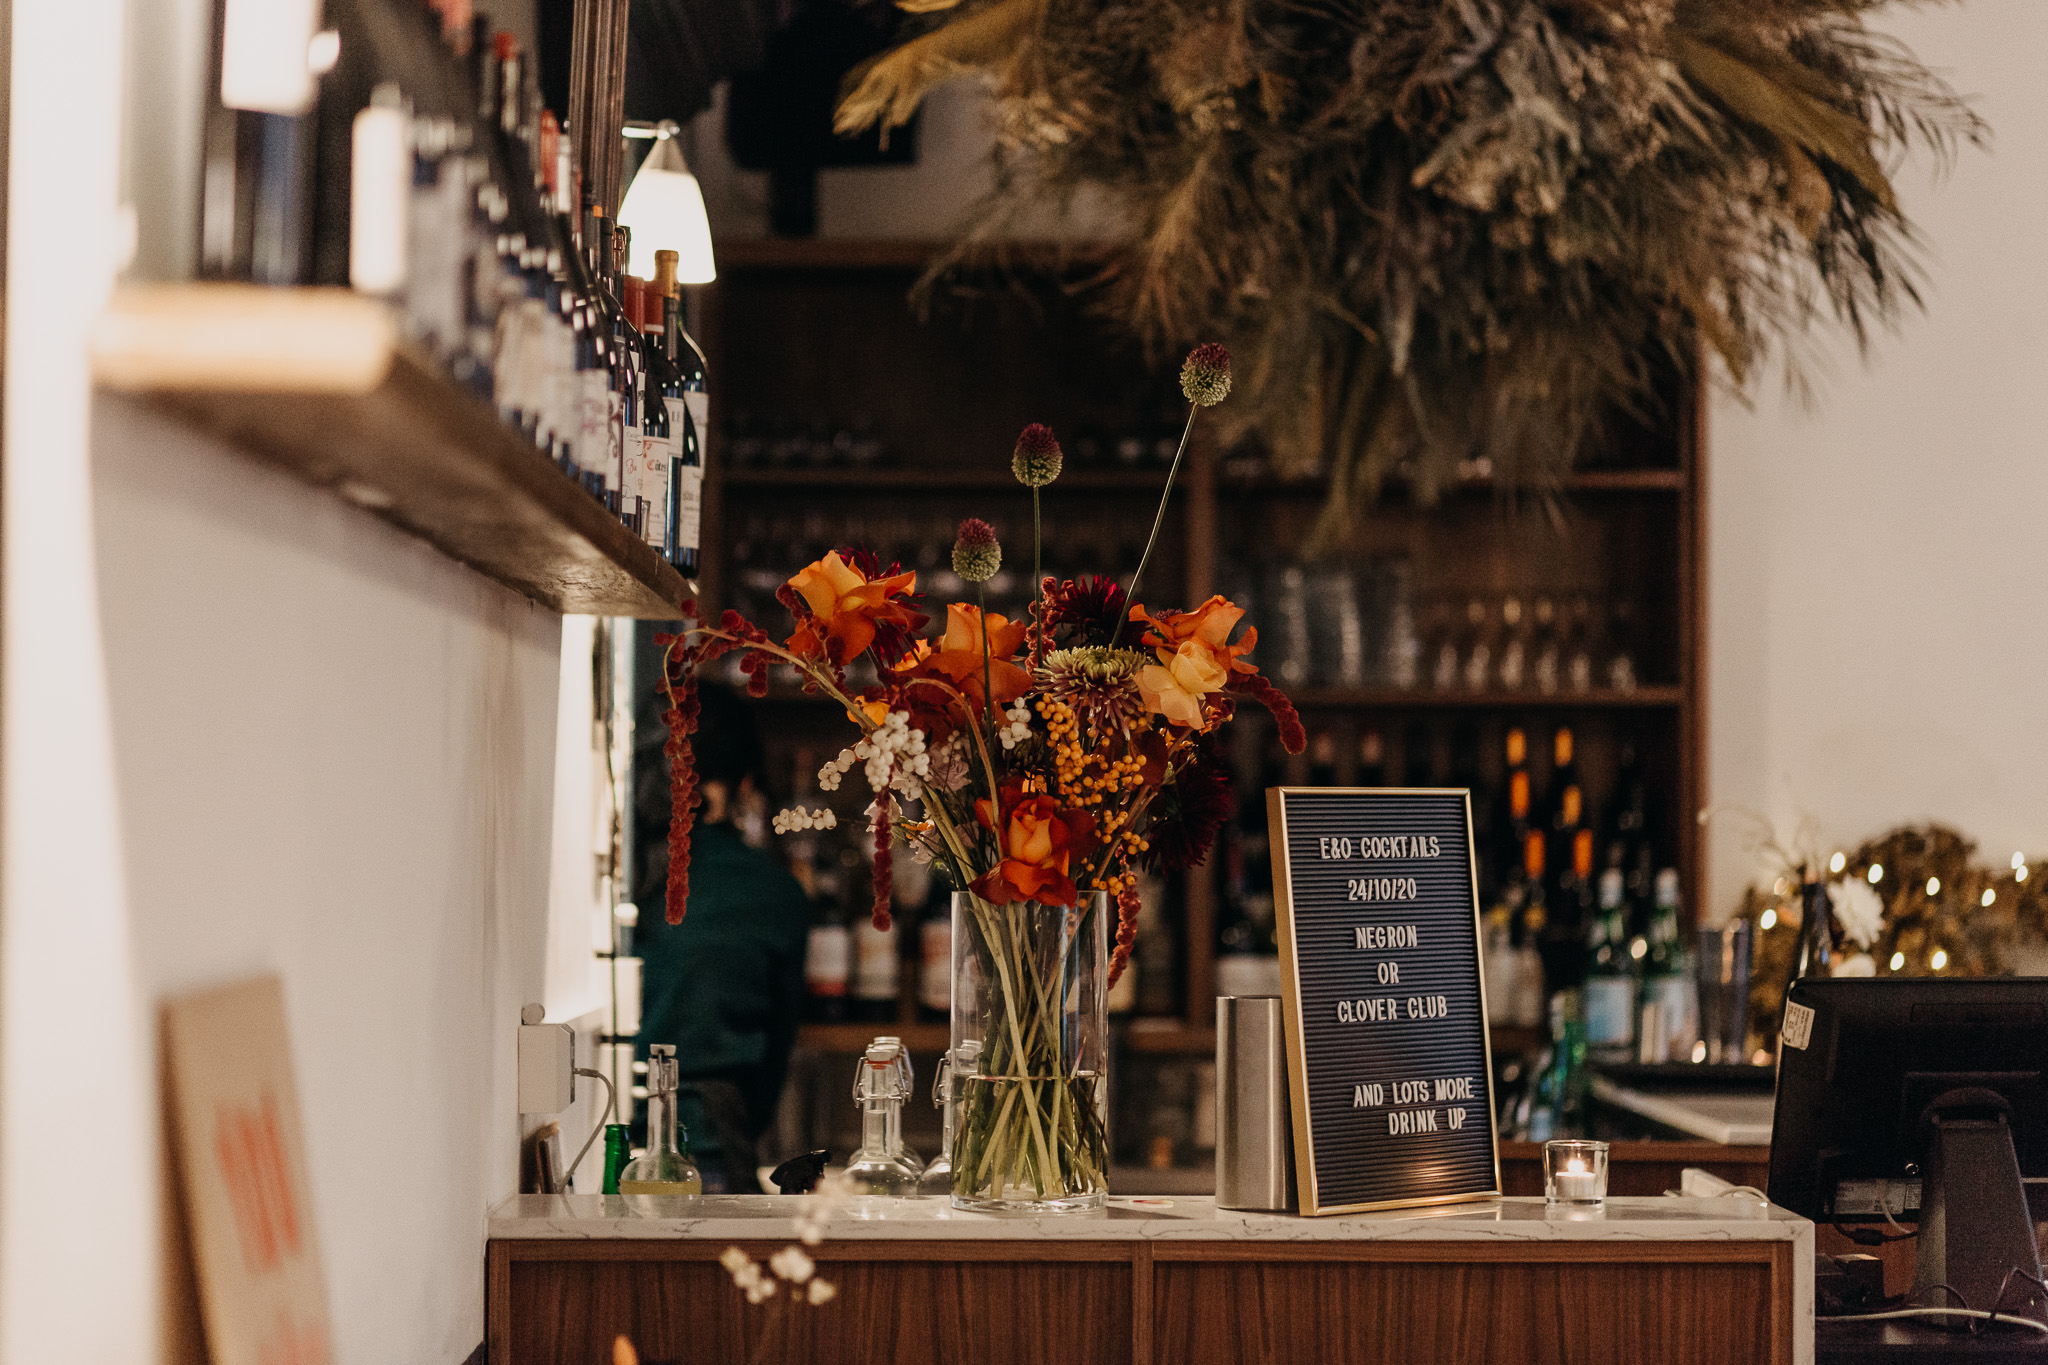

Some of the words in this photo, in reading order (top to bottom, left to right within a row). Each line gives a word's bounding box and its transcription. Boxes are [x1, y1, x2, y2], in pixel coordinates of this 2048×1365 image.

[1319, 837, 1351, 860] E&O
[1360, 836, 1441, 858] COCKTAILS
[1347, 878, 1417, 901] 24/10/20
[1355, 925, 1418, 949] NEGRON
[1377, 961, 1400, 985] OR
[1337, 998, 1398, 1023] CLOVER
[1407, 995, 1448, 1019] CLUB
[1353, 1083, 1384, 1108] AND
[1392, 1080, 1430, 1104] LOTS
[1434, 1077, 1475, 1101] MORE
[1388, 1109, 1438, 1135] DRINK
[1447, 1107, 1466, 1130] UP
